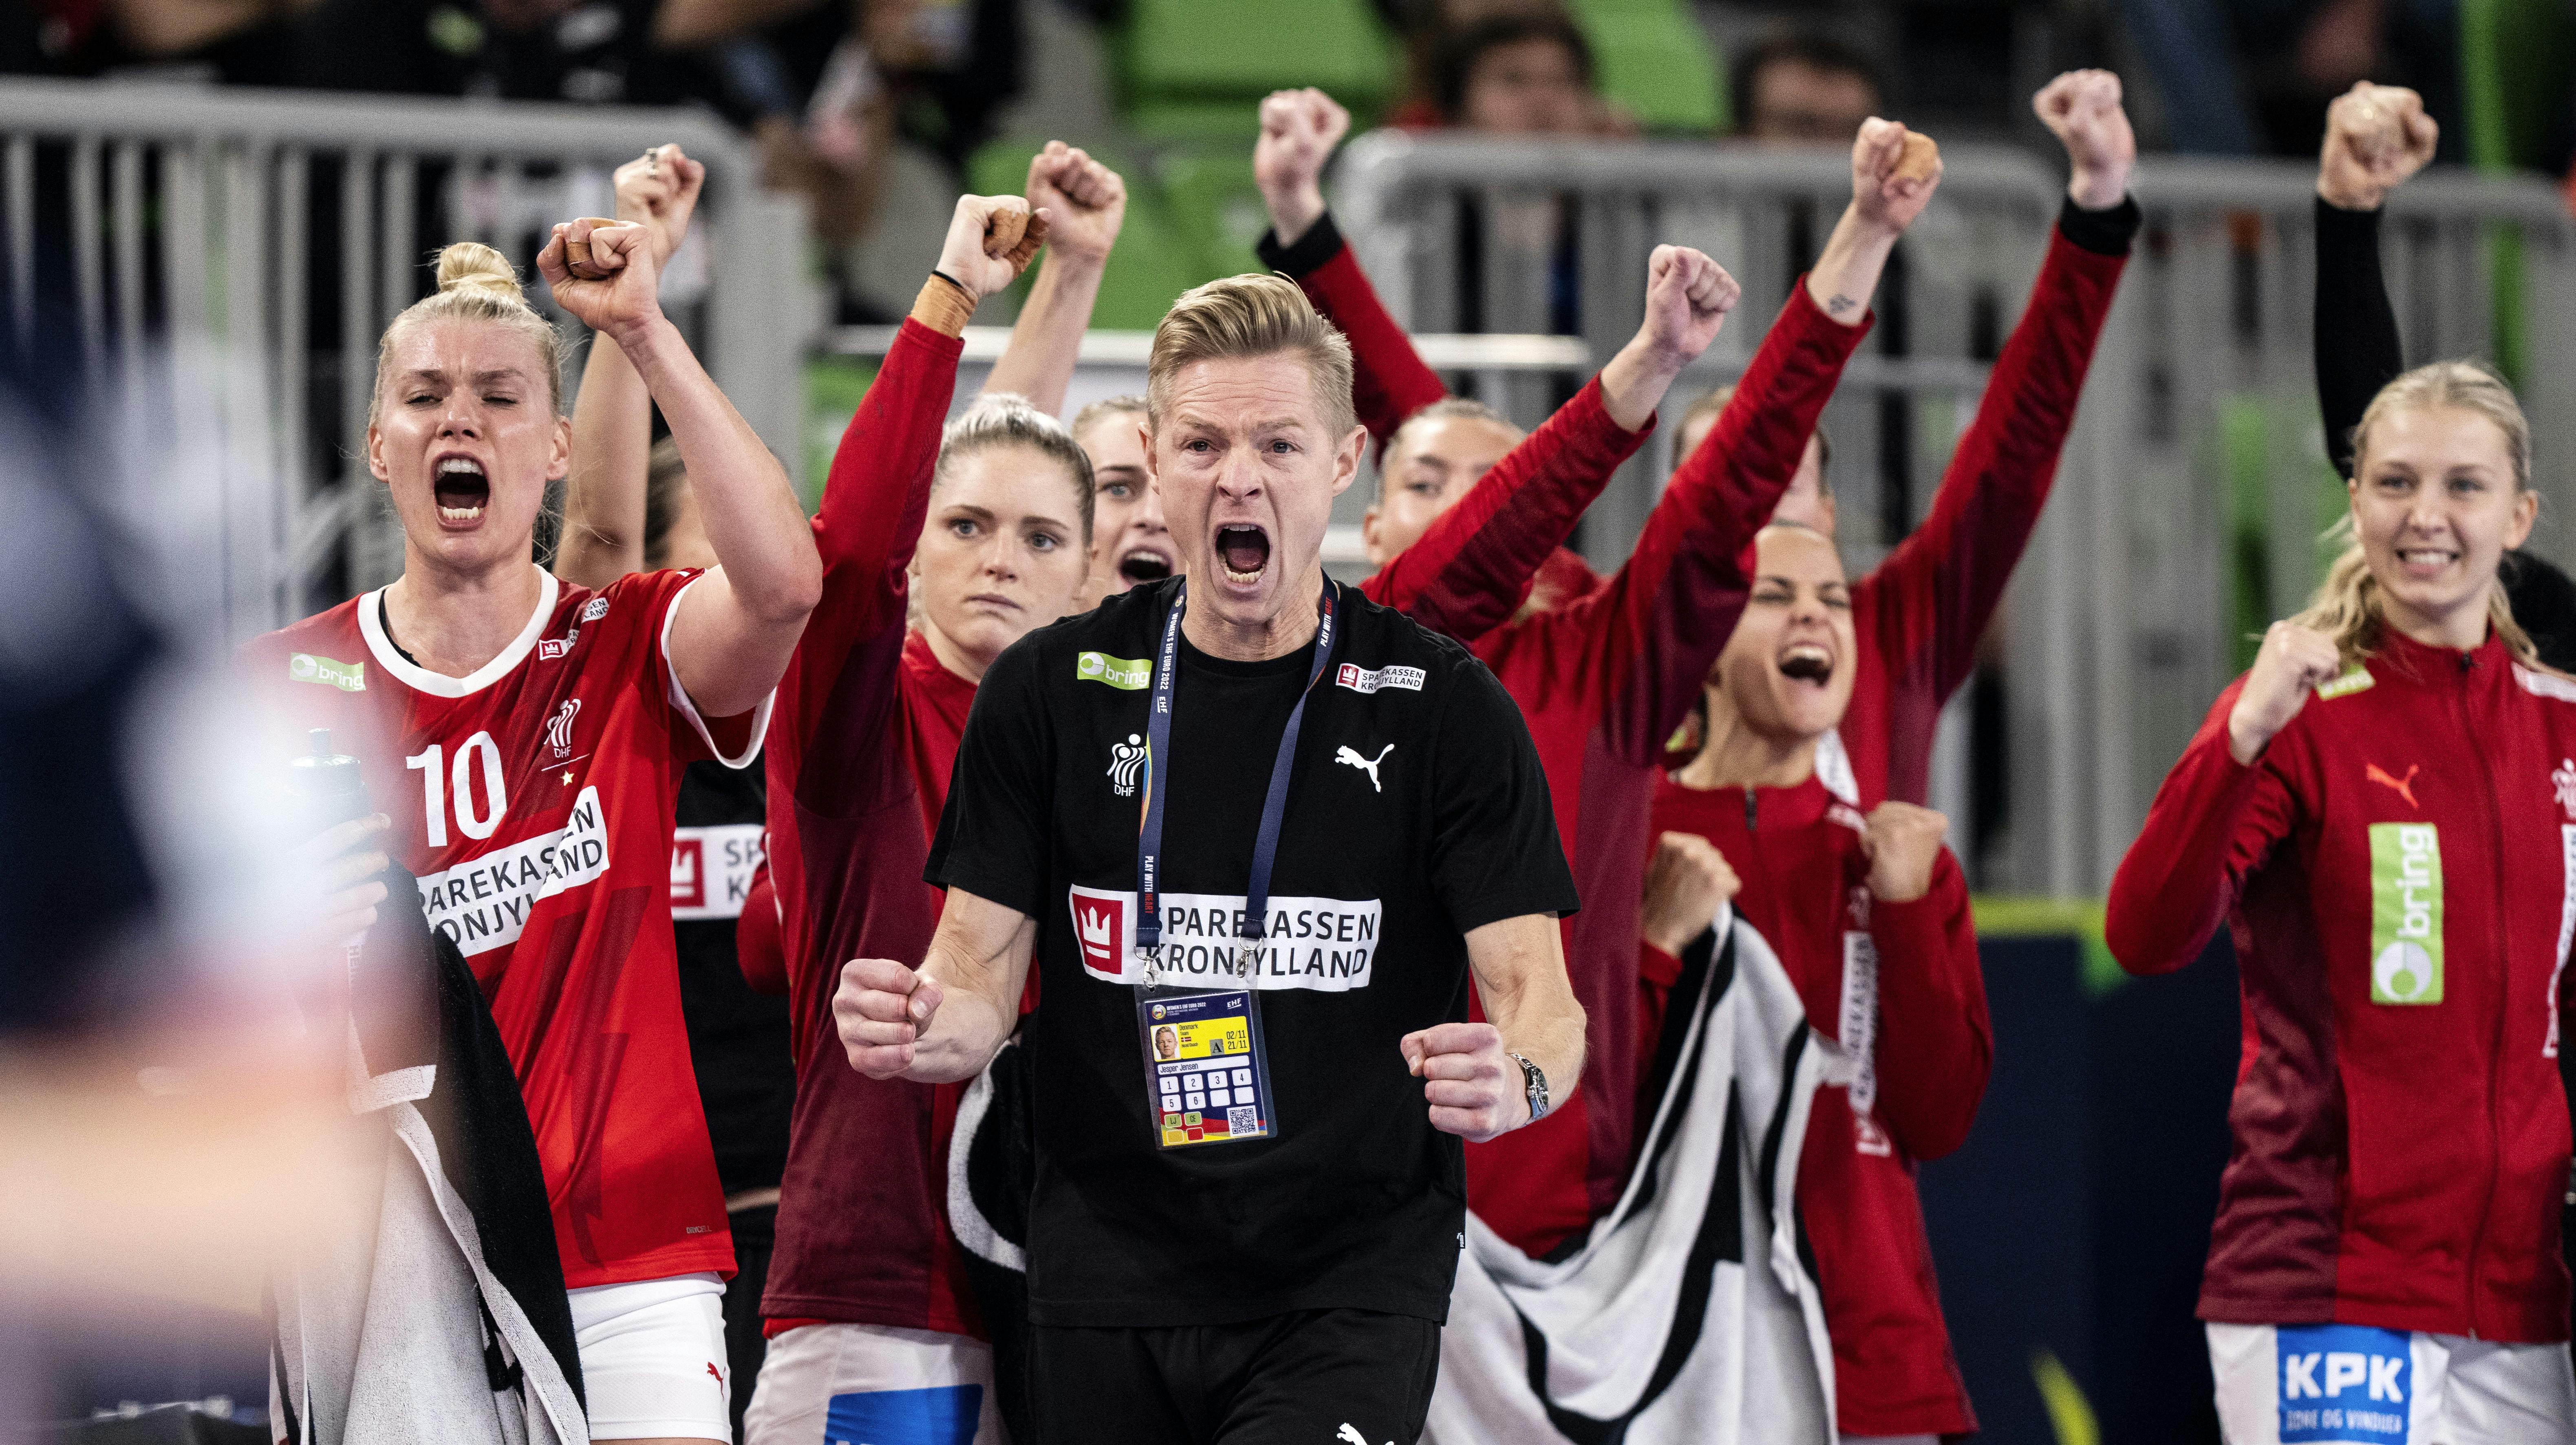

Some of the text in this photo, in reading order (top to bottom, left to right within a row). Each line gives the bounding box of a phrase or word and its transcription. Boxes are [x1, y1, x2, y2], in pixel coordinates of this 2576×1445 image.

[1323, 613, 1331, 632] WITH
[1320, 630, 1329, 647] PLAY
[1160, 613, 1178, 691] WOMEN'S EHF EURO 2022
[319, 665, 366, 691] bring
[1105, 664, 1149, 687] bring
[1159, 696, 1168, 713] EHF
[554, 746, 571, 758] DHF
[406, 730, 508, 847] 10
[1114, 784, 1135, 796] DHF
[1145, 856, 1153, 913] PLAY WITH HEART
[2395, 827, 2435, 937] bring
[1157, 907, 1375, 942] PAREASSEN
[1147, 943, 1367, 978] KRONYLLAND
[1227, 998, 1242, 1008] EHF
[1226, 1030, 1246, 1040] 02/11
[1212, 1042, 1222, 1053] A
[1228, 1040, 1247, 1050] 21/11
[1160, 1063, 1198, 1074] Jesper Jensen
[1167, 1073, 1244, 1090] 1 2 3 4
[1169, 1096, 1198, 1107] 5 6
[2285, 1352, 2404, 1403] KPK
